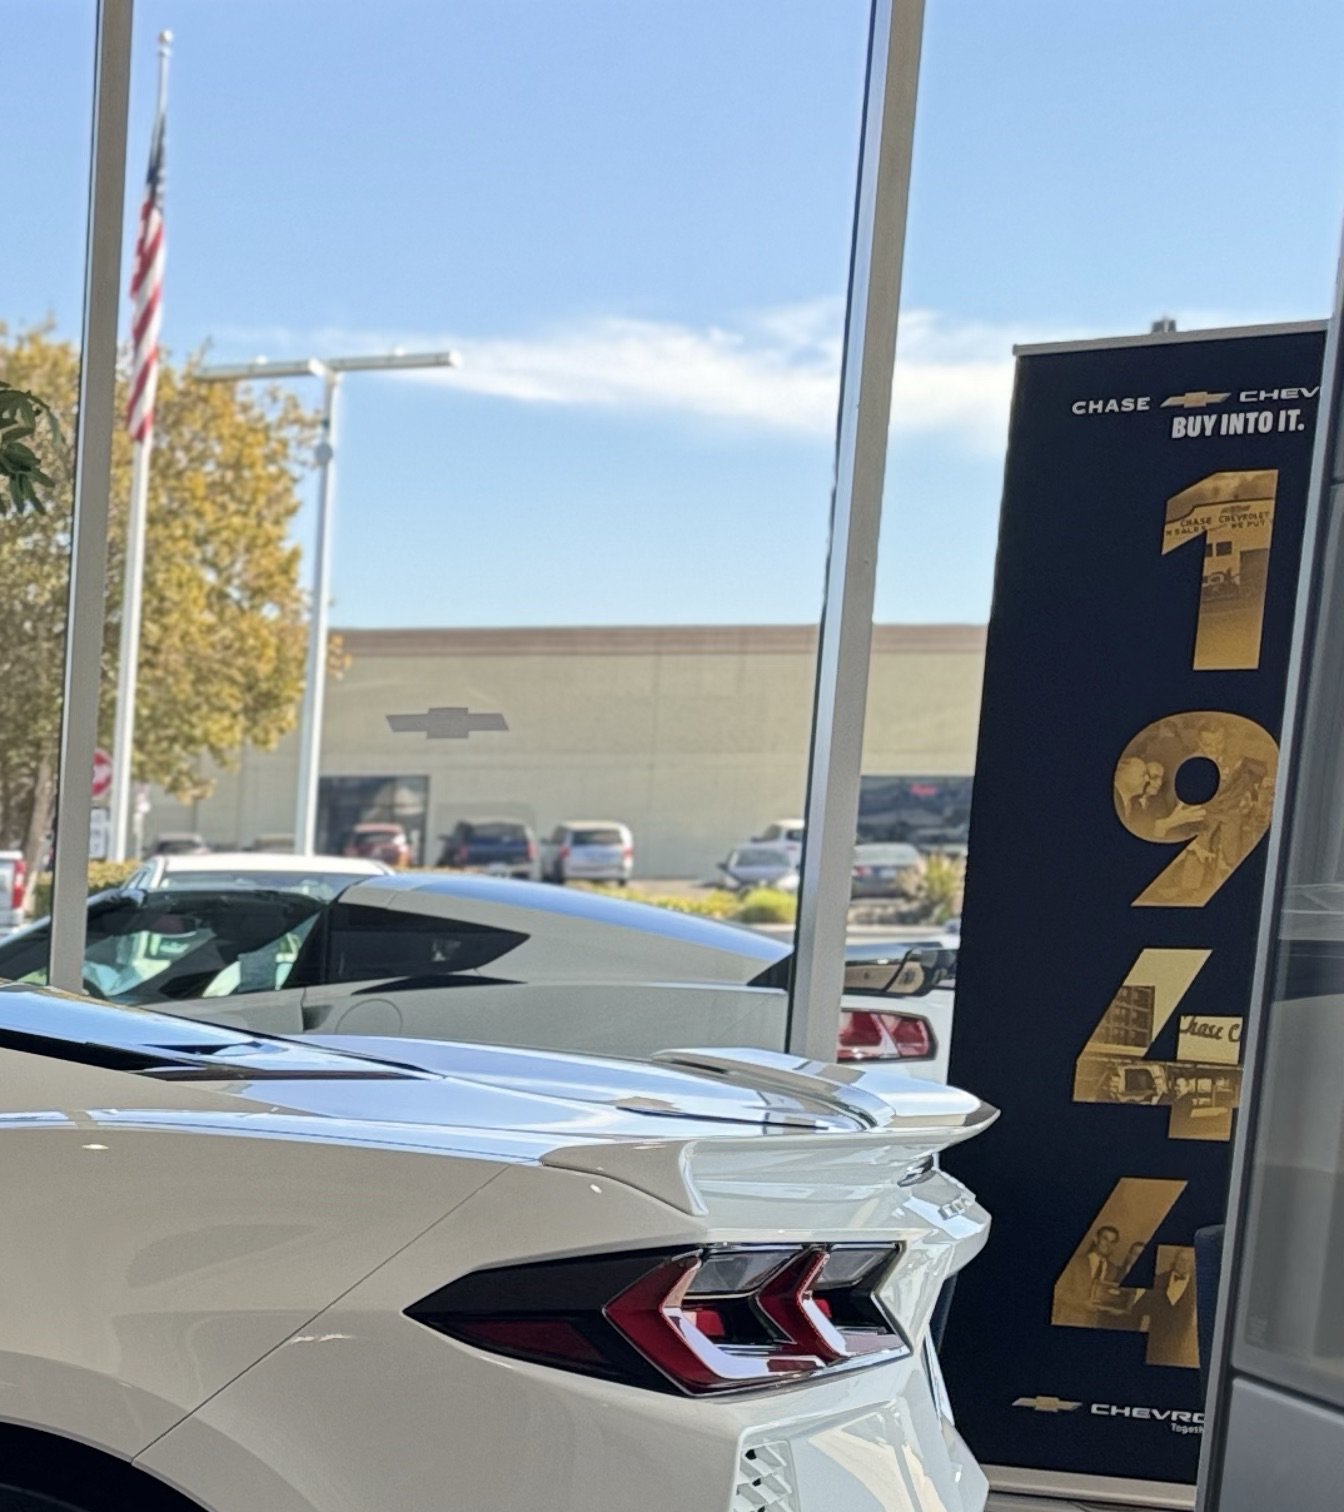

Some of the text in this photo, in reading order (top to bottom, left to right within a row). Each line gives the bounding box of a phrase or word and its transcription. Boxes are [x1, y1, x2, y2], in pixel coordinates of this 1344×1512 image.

[1072, 386, 1320, 415] CHASE CHEV
[1171, 409, 1305, 439] BUY INTO IT.
[1180, 511, 1270, 527] CHASE CHEVROLET
